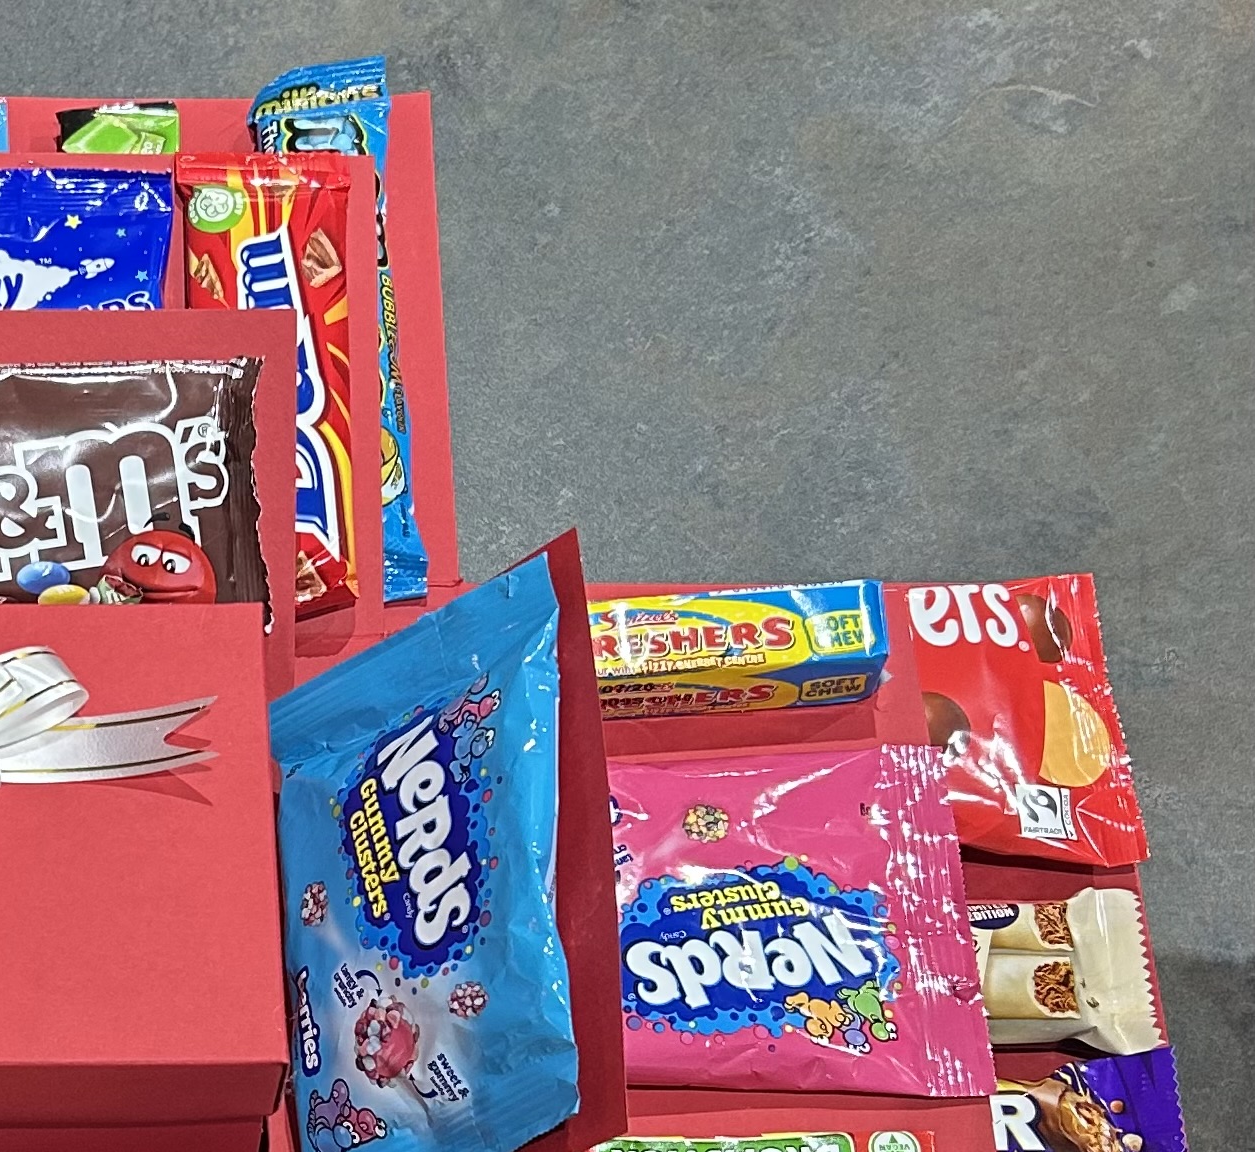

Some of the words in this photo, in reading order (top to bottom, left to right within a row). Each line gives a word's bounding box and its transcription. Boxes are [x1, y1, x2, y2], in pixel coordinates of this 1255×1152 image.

[805, 683, 862, 698] CHEW
[809, 676, 861, 689] SOFT
[359, 778, 401, 884] Gummy
[700, 894, 811, 930] Gummy
[436, 1053, 463, 1087] sweet
[878, 1143, 910, 1151] VEGAN
